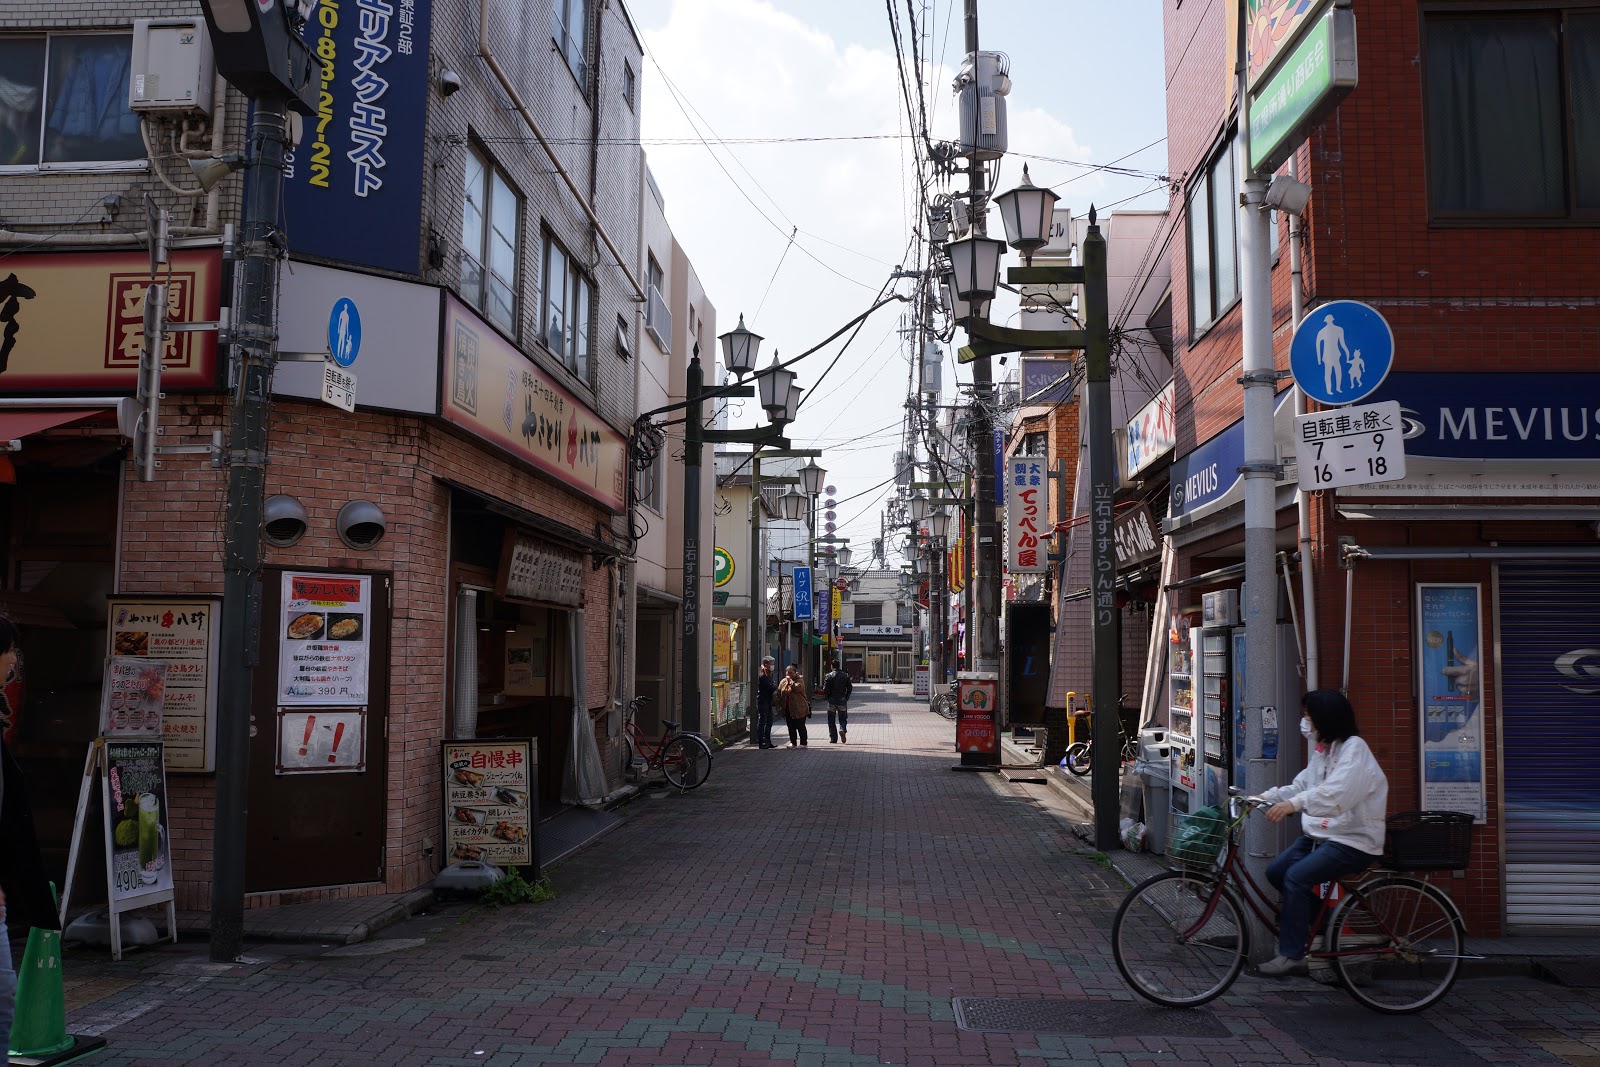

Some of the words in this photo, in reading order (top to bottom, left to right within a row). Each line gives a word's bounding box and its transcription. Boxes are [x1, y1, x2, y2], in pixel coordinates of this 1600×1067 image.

[326, 384, 333, 398] 15
[1303, 411, 1392, 439] 自転車を除く
[1312, 442, 1324, 460] 7
[1373, 434, 1384, 452] 9
[1015, 463, 1026, 486] 割烹
[1029, 463, 1041, 486] 大衆
[1314, 464, 1332, 483] 16
[1368, 457, 1387, 476] 18
[1185, 463, 1218, 504] MEVIUS
[1018, 489, 1038, 567] てっぺん屋
[1094, 483, 1112, 626] 立石すずらん通り
[295, 582, 358, 596] 懐かしい味
[796, 590, 810, 602] R
[318, 687, 336, 695] 390
[471, 749, 523, 769] 自慢串
